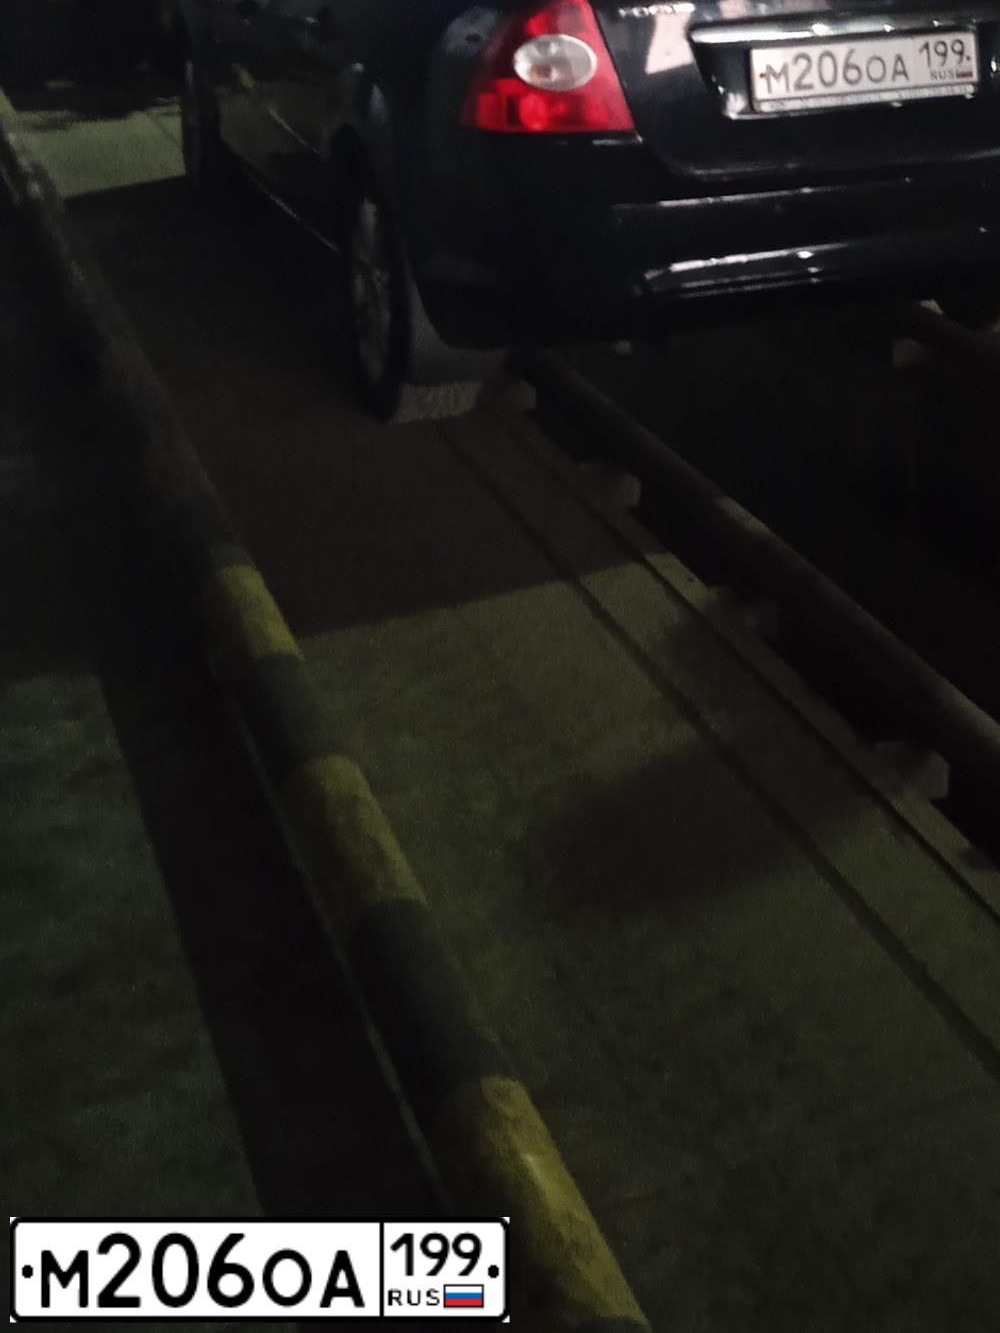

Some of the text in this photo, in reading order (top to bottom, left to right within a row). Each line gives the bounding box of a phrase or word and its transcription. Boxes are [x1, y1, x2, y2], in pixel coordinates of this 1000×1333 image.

[763, 39, 966, 95] М206ОА 199
[930, 69, 955, 80] RUS
